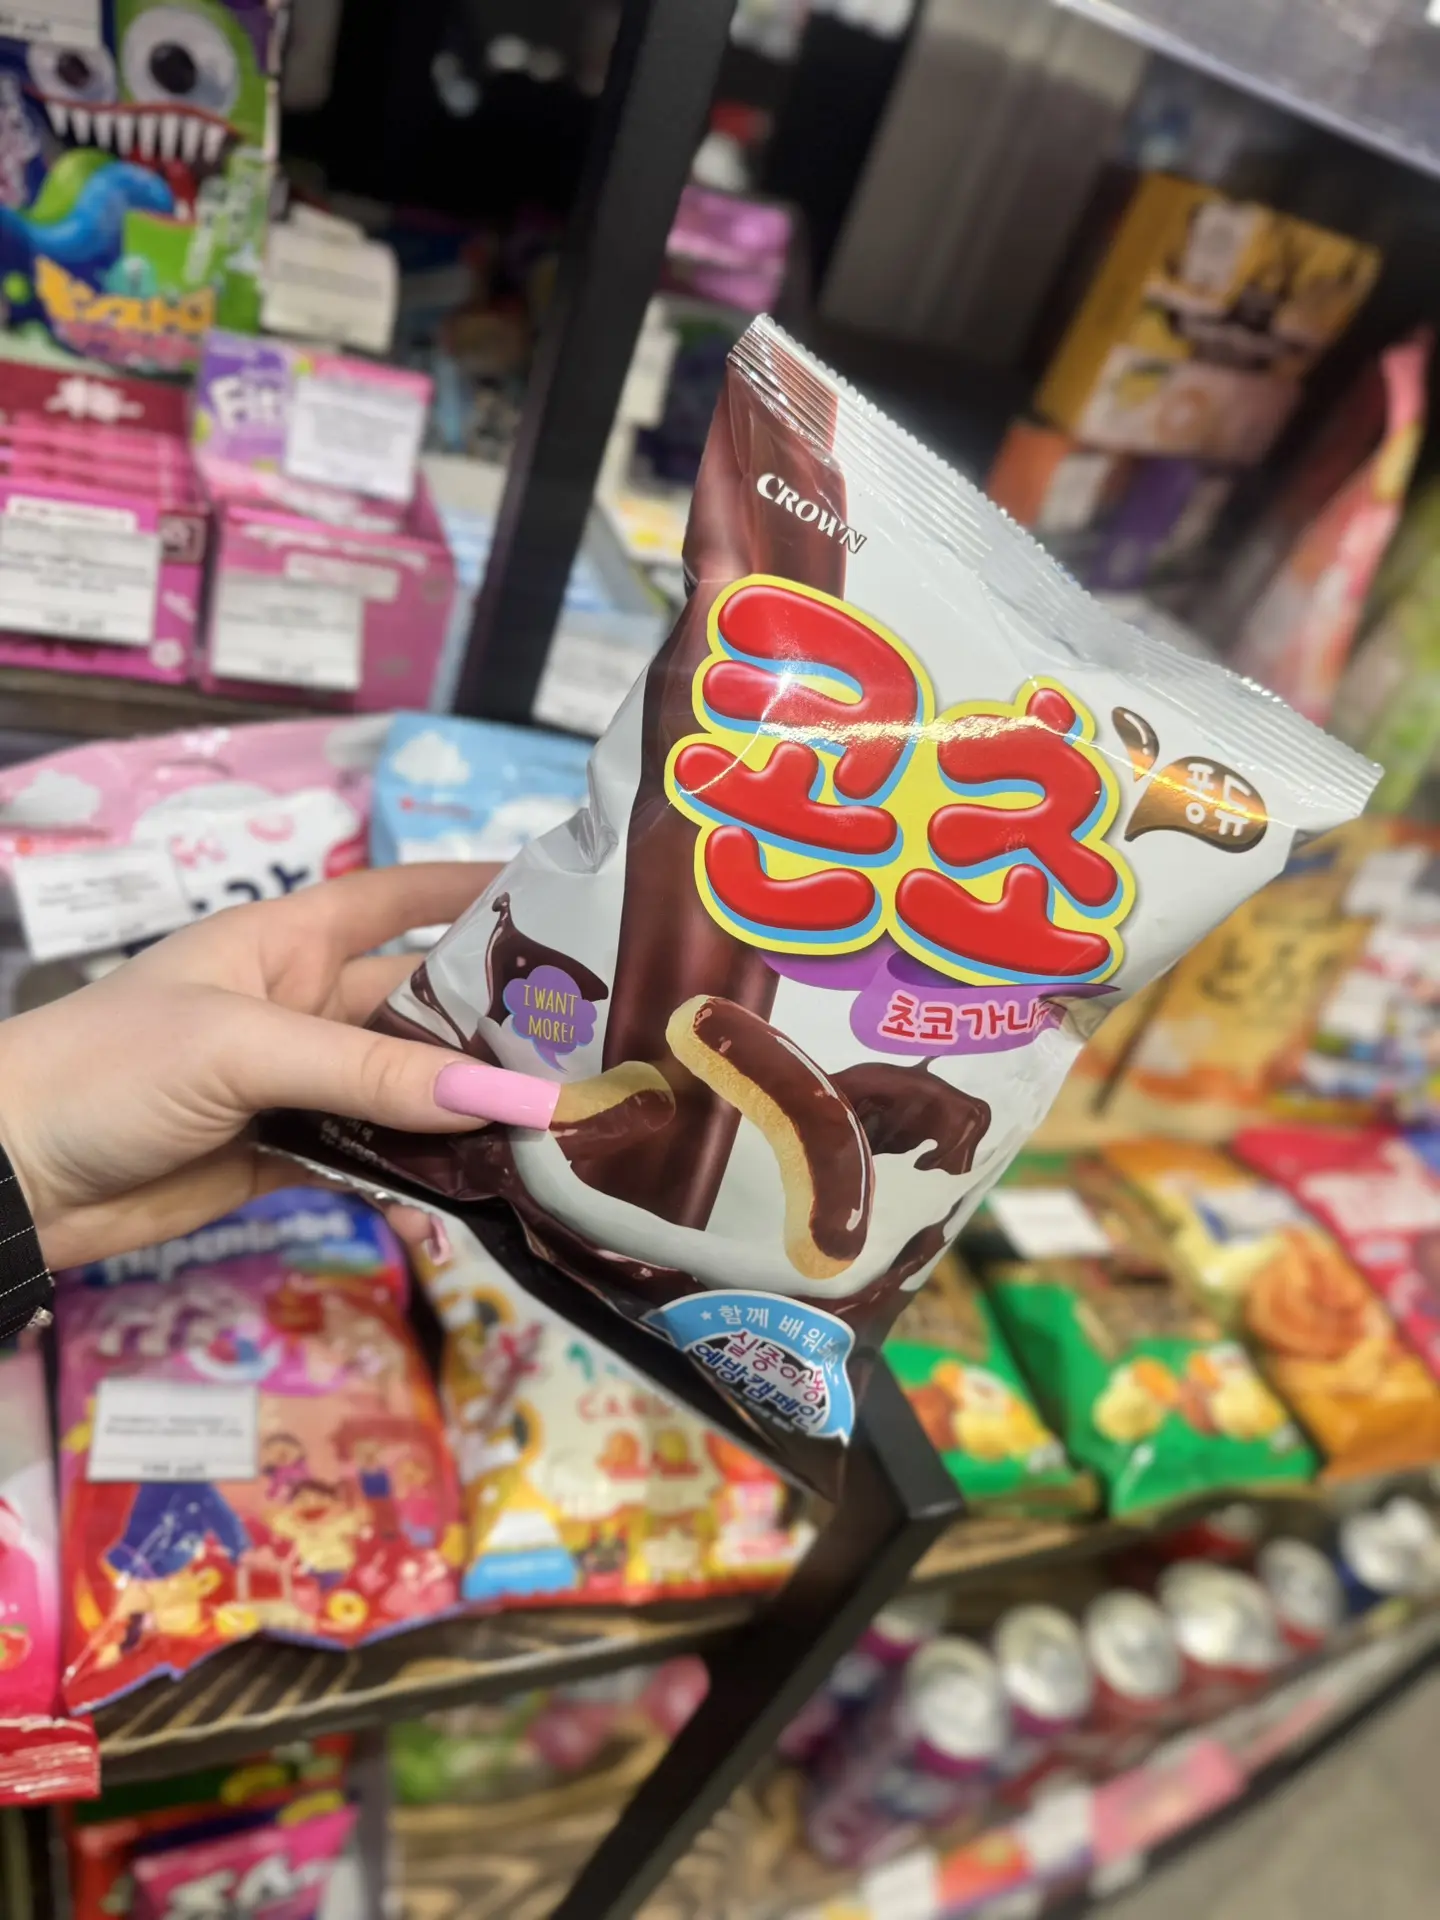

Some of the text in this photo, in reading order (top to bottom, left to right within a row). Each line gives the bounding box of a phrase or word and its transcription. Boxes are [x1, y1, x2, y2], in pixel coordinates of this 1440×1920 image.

[756, 472, 867, 554] CROWN
[668, 578, 1128, 984] 콘초
[1184, 762, 1252, 838] 퐁듀
[523, 984, 578, 1018] I WANT
[528, 1014, 575, 1044] MORE!
[717, 1303, 770, 1329] 함께
[695, 1344, 826, 1432] 예방캠페인
[725, 1330, 827, 1404] 실종아동
